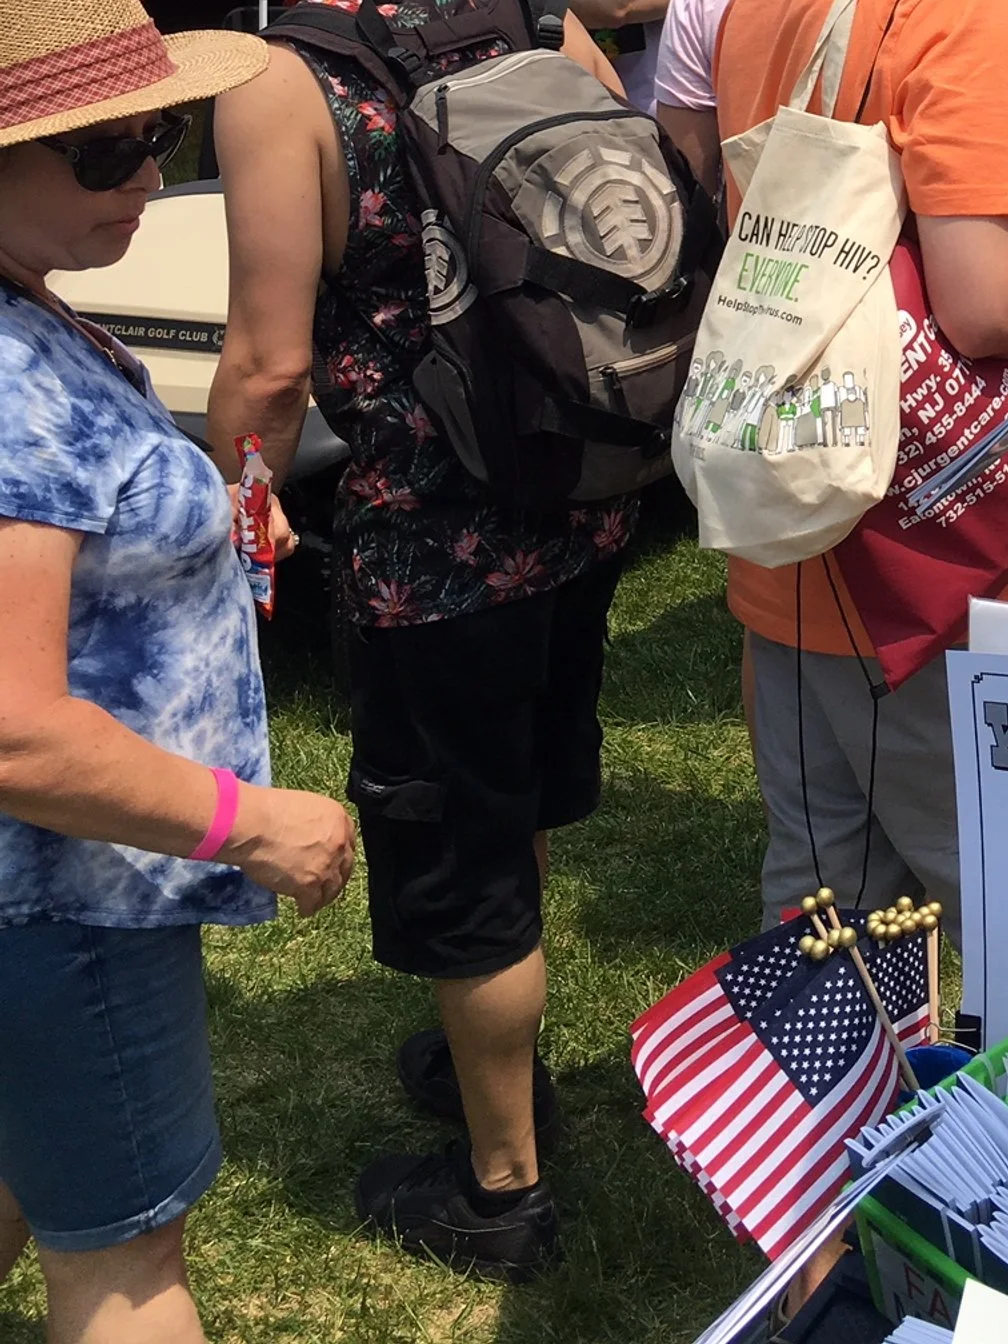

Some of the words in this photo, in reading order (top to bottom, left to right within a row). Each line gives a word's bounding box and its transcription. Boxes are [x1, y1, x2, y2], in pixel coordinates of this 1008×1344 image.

[738, 211, 775, 248] CAN
[833, 238, 881, 281] HIV?
[102, 323, 145, 337] NTCLAIR
[147, 327, 177, 340] GOLF
[178, 330, 208, 343] CLUB
[900, 330, 933, 383] ENT
[899, 373, 941, 414] Hwy.
[937, 348, 953, 373] 35
[917, 393, 945, 425] NJ
[897, 441, 925, 466] 32)
[924, 376, 987, 446] 455-8444
